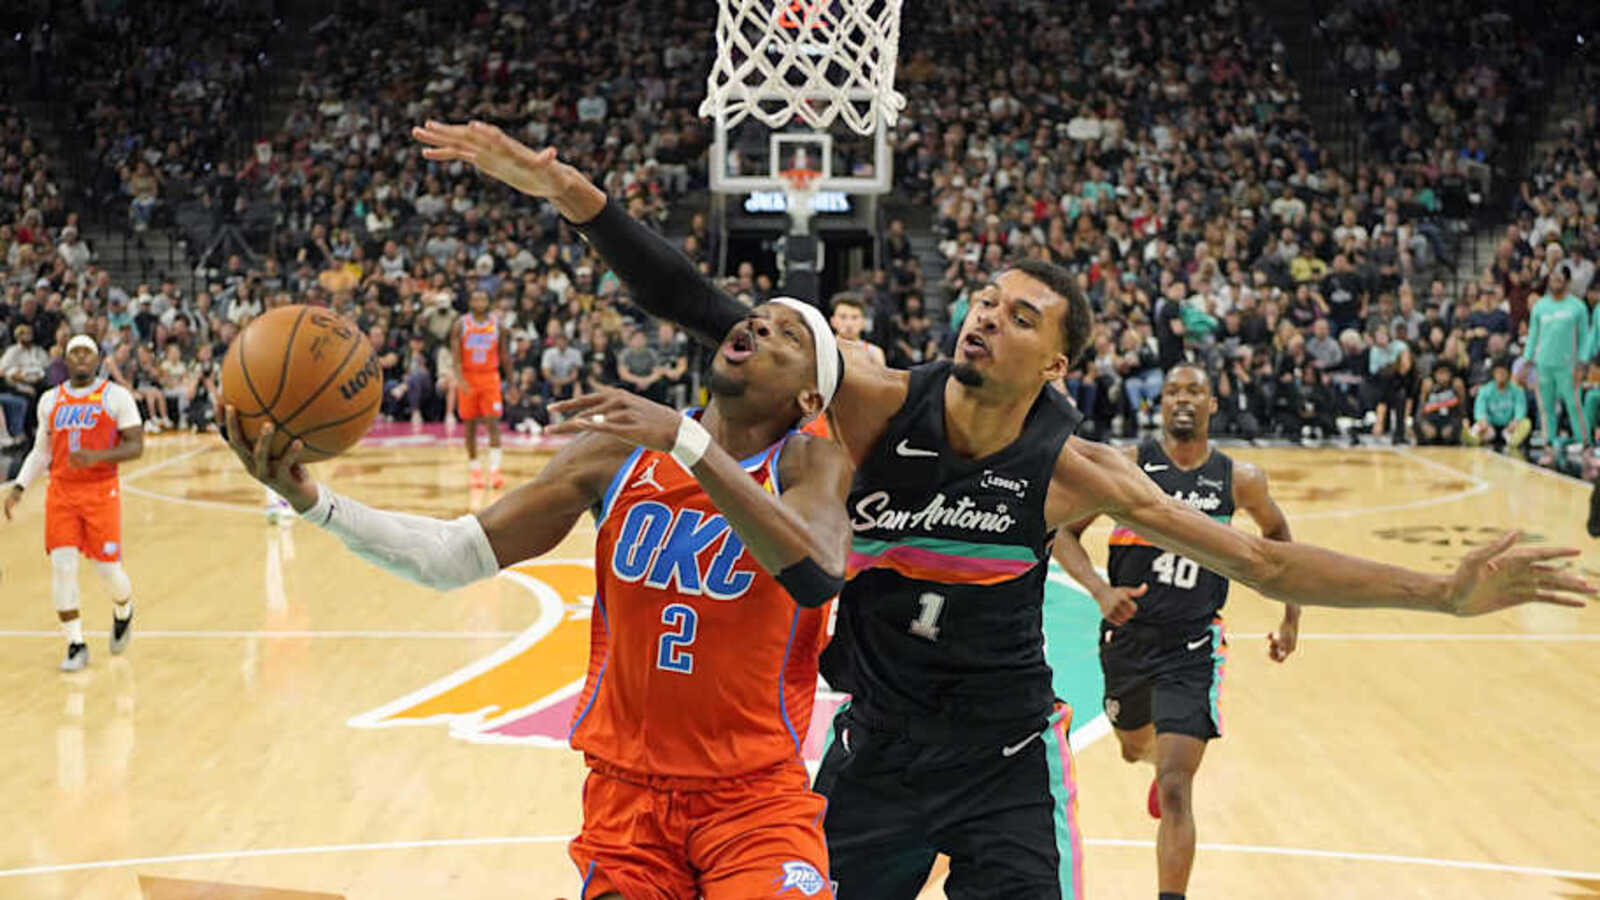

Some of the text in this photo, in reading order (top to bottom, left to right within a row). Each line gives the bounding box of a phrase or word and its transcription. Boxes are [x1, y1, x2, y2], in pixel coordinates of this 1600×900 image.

[54, 404, 102, 429] OKC
[852, 491, 1016, 534] San Antonio
[612, 500, 755, 600] OKC
[1152, 552, 1199, 590] 40
[656, 603, 698, 675] 2
[908, 591, 945, 642] 1
